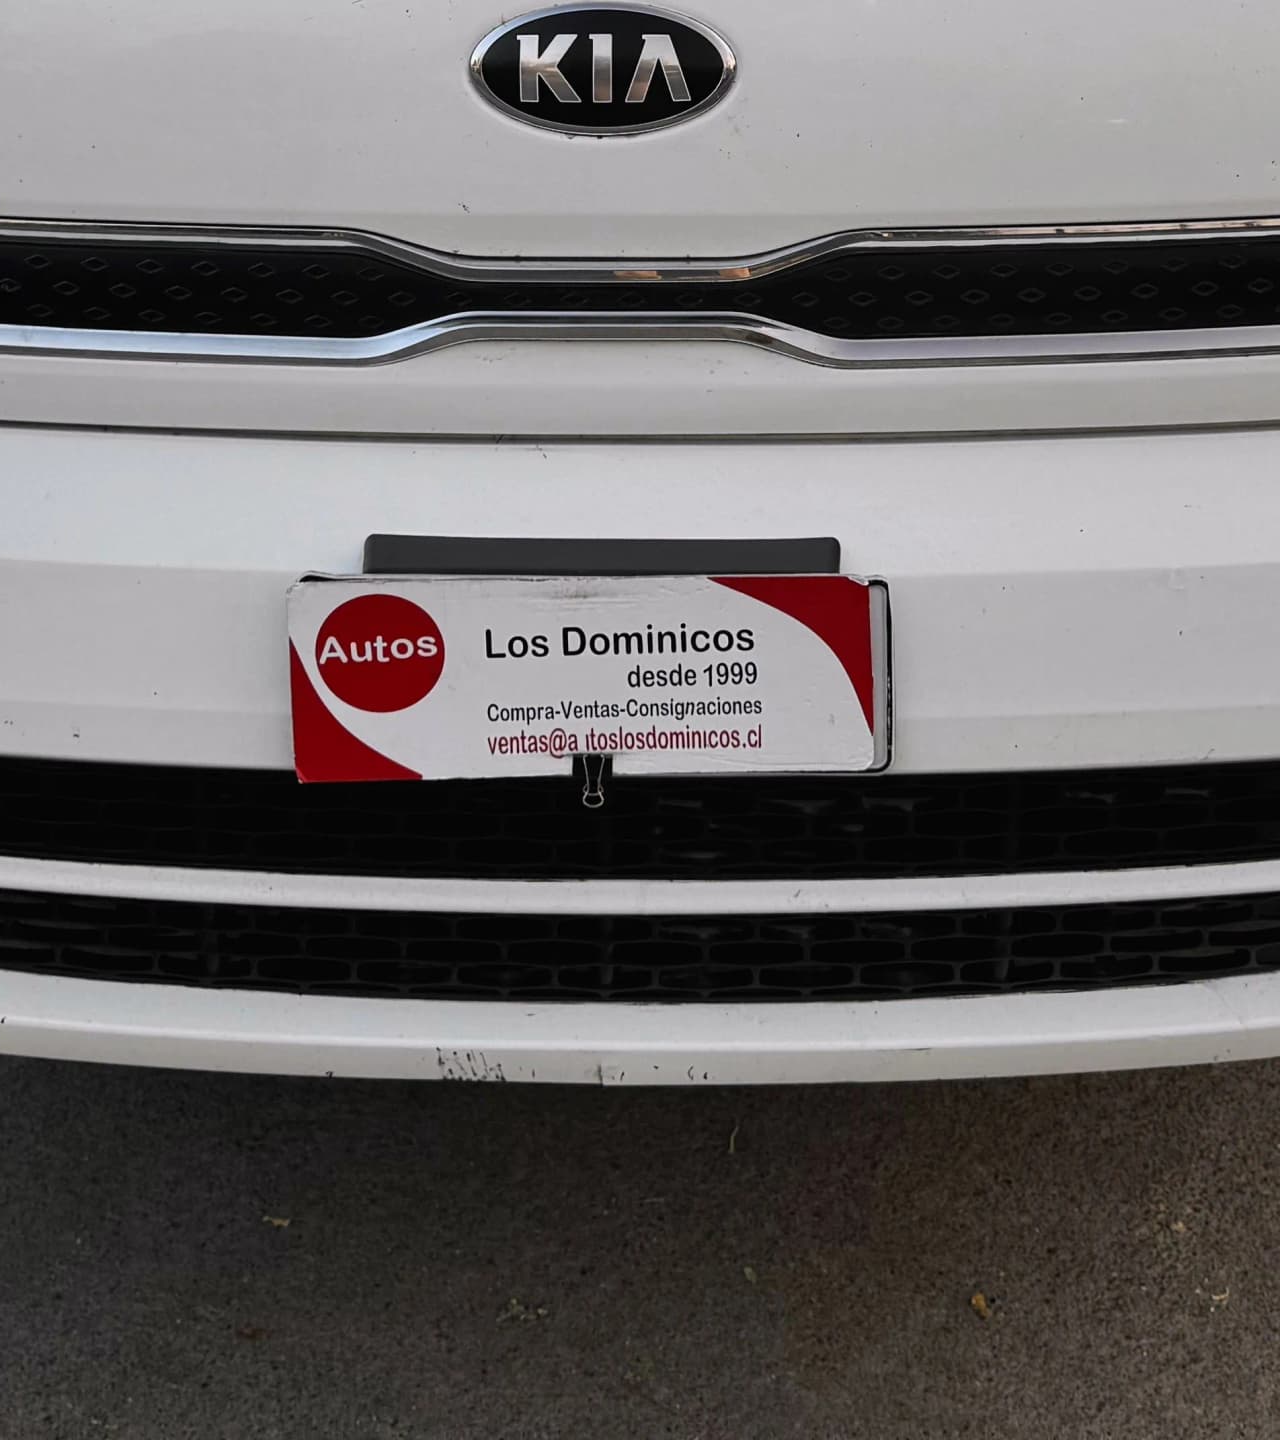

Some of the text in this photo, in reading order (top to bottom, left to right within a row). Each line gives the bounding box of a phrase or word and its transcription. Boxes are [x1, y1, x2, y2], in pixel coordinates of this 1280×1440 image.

[516, 33, 691, 104] KIA
[319, 635, 438, 665] Autos
[485, 622, 755, 659] Los Dominicos
[627, 662, 759, 688] desde 1999
